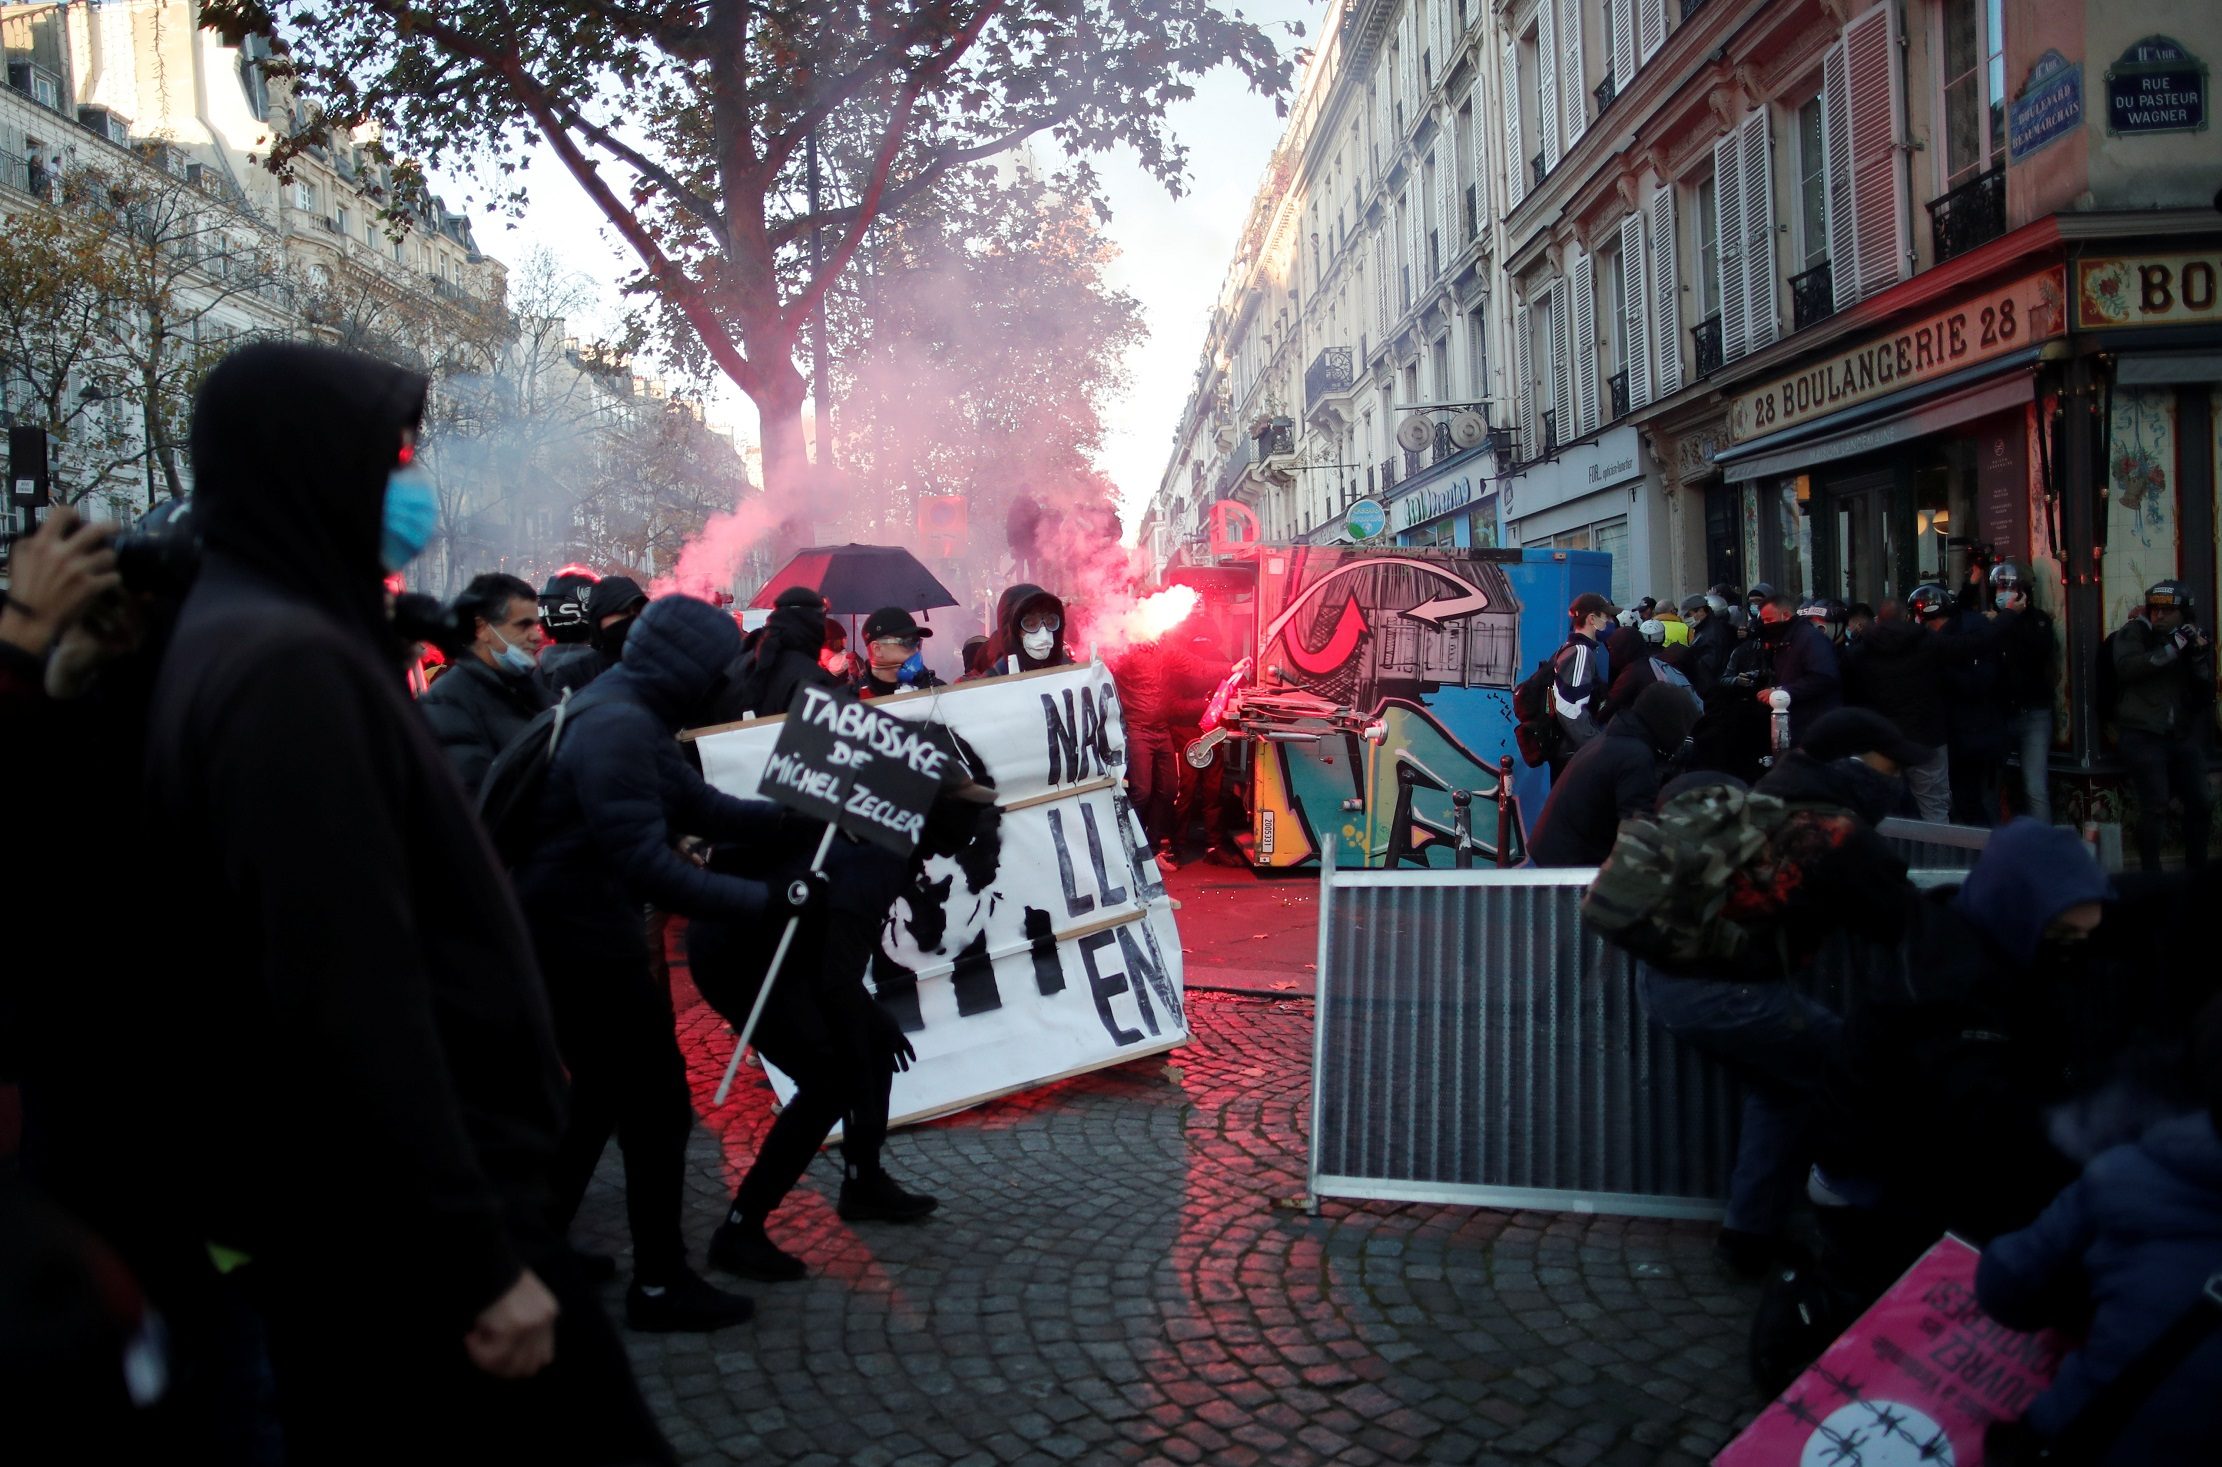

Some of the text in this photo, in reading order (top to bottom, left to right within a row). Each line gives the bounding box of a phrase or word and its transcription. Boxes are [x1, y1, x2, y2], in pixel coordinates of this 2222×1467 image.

[2116, 91, 2198, 109] DU PASTEUR
[2142, 77, 2170, 90] RUE
[2018, 84, 2071, 125] BOULEVARD
[2127, 109, 2188, 125] WAGNER
[2012, 100, 2080, 148] BEAUMARCHAIS
[2138, 261, 2222, 315] BO
[1755, 297, 2016, 429] 28 BOULANGERIE 28
[825, 741, 874, 769] DE
[844, 782, 926, 845] ZECLER
[1263, 818, 1273, 847] 2005331
